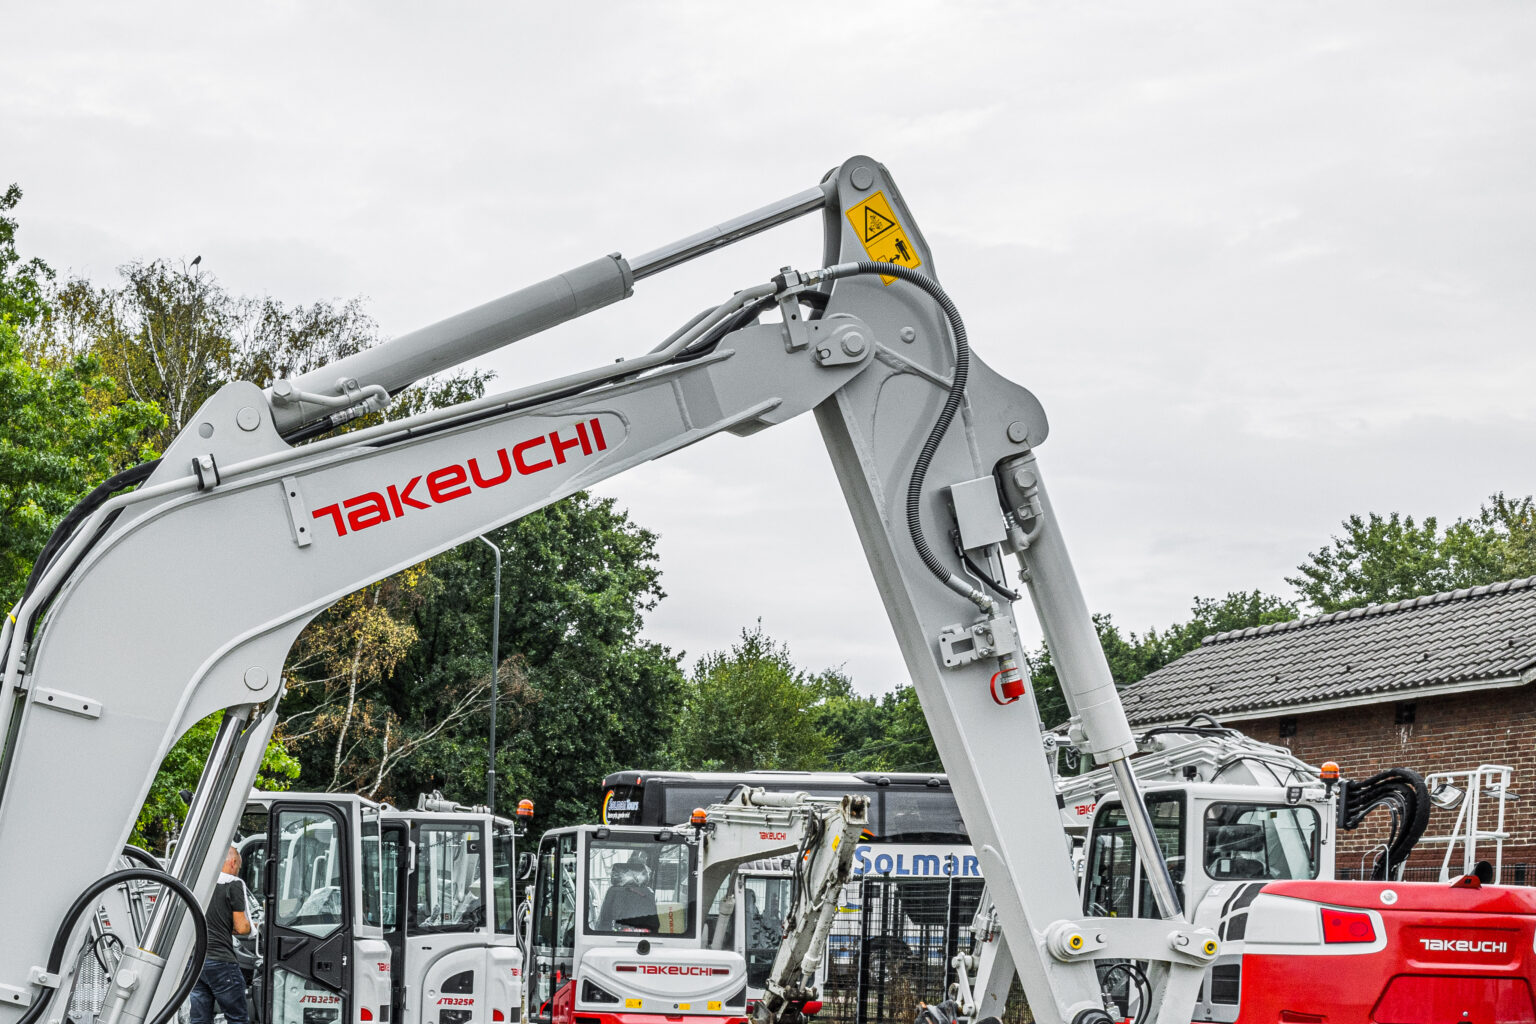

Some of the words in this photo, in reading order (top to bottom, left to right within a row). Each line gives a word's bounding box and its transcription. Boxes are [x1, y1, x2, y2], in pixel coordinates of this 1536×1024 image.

[312, 418, 607, 537] TAKEUCHI
[1419, 938, 1507, 953] TAKEUCHI
[638, 965, 712, 976] TAKEUCHI
